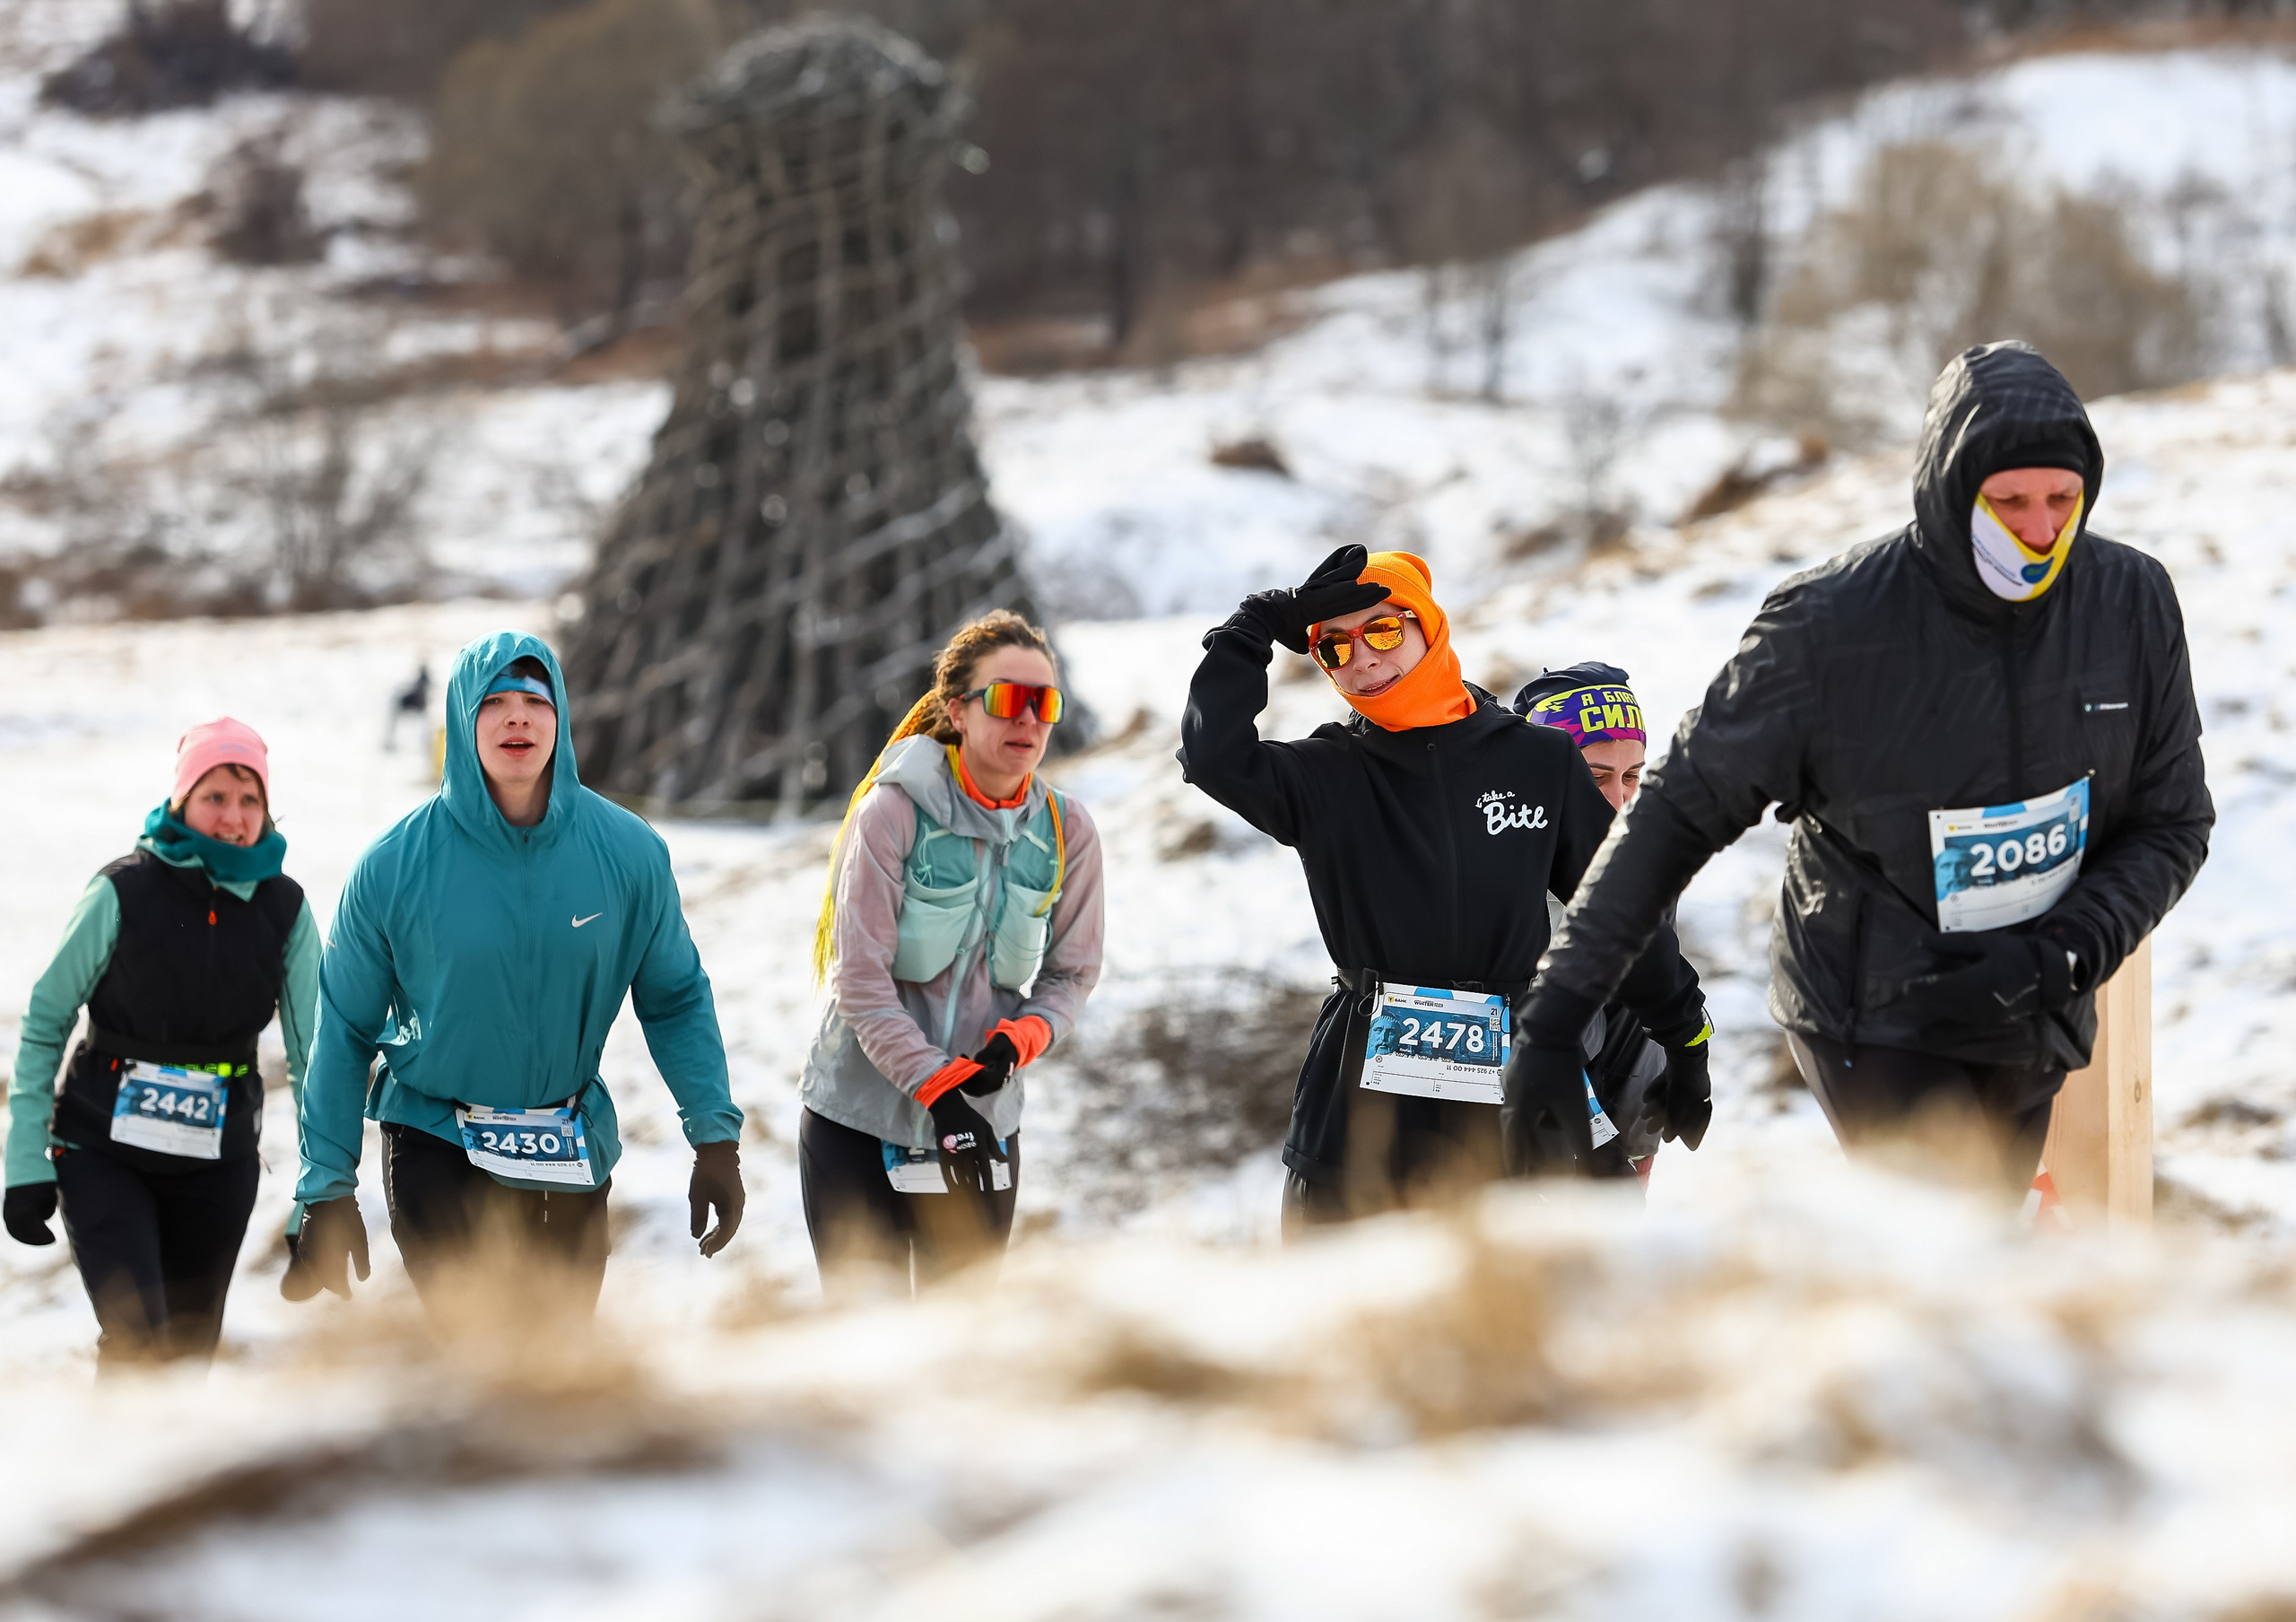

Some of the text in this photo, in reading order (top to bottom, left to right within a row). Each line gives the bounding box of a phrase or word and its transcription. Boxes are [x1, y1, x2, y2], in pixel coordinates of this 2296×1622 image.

[1580, 693, 1595, 707] Я
[1481, 789, 1506, 803] take
[1483, 801, 1548, 835] Bite
[1970, 823, 2067, 877] 2086
[1490, 1007, 1498, 1016] 21
[1398, 1017, 1484, 1053] 2478
[140, 1087, 210, 1121] 2442
[481, 1131, 561, 1155] 2430
